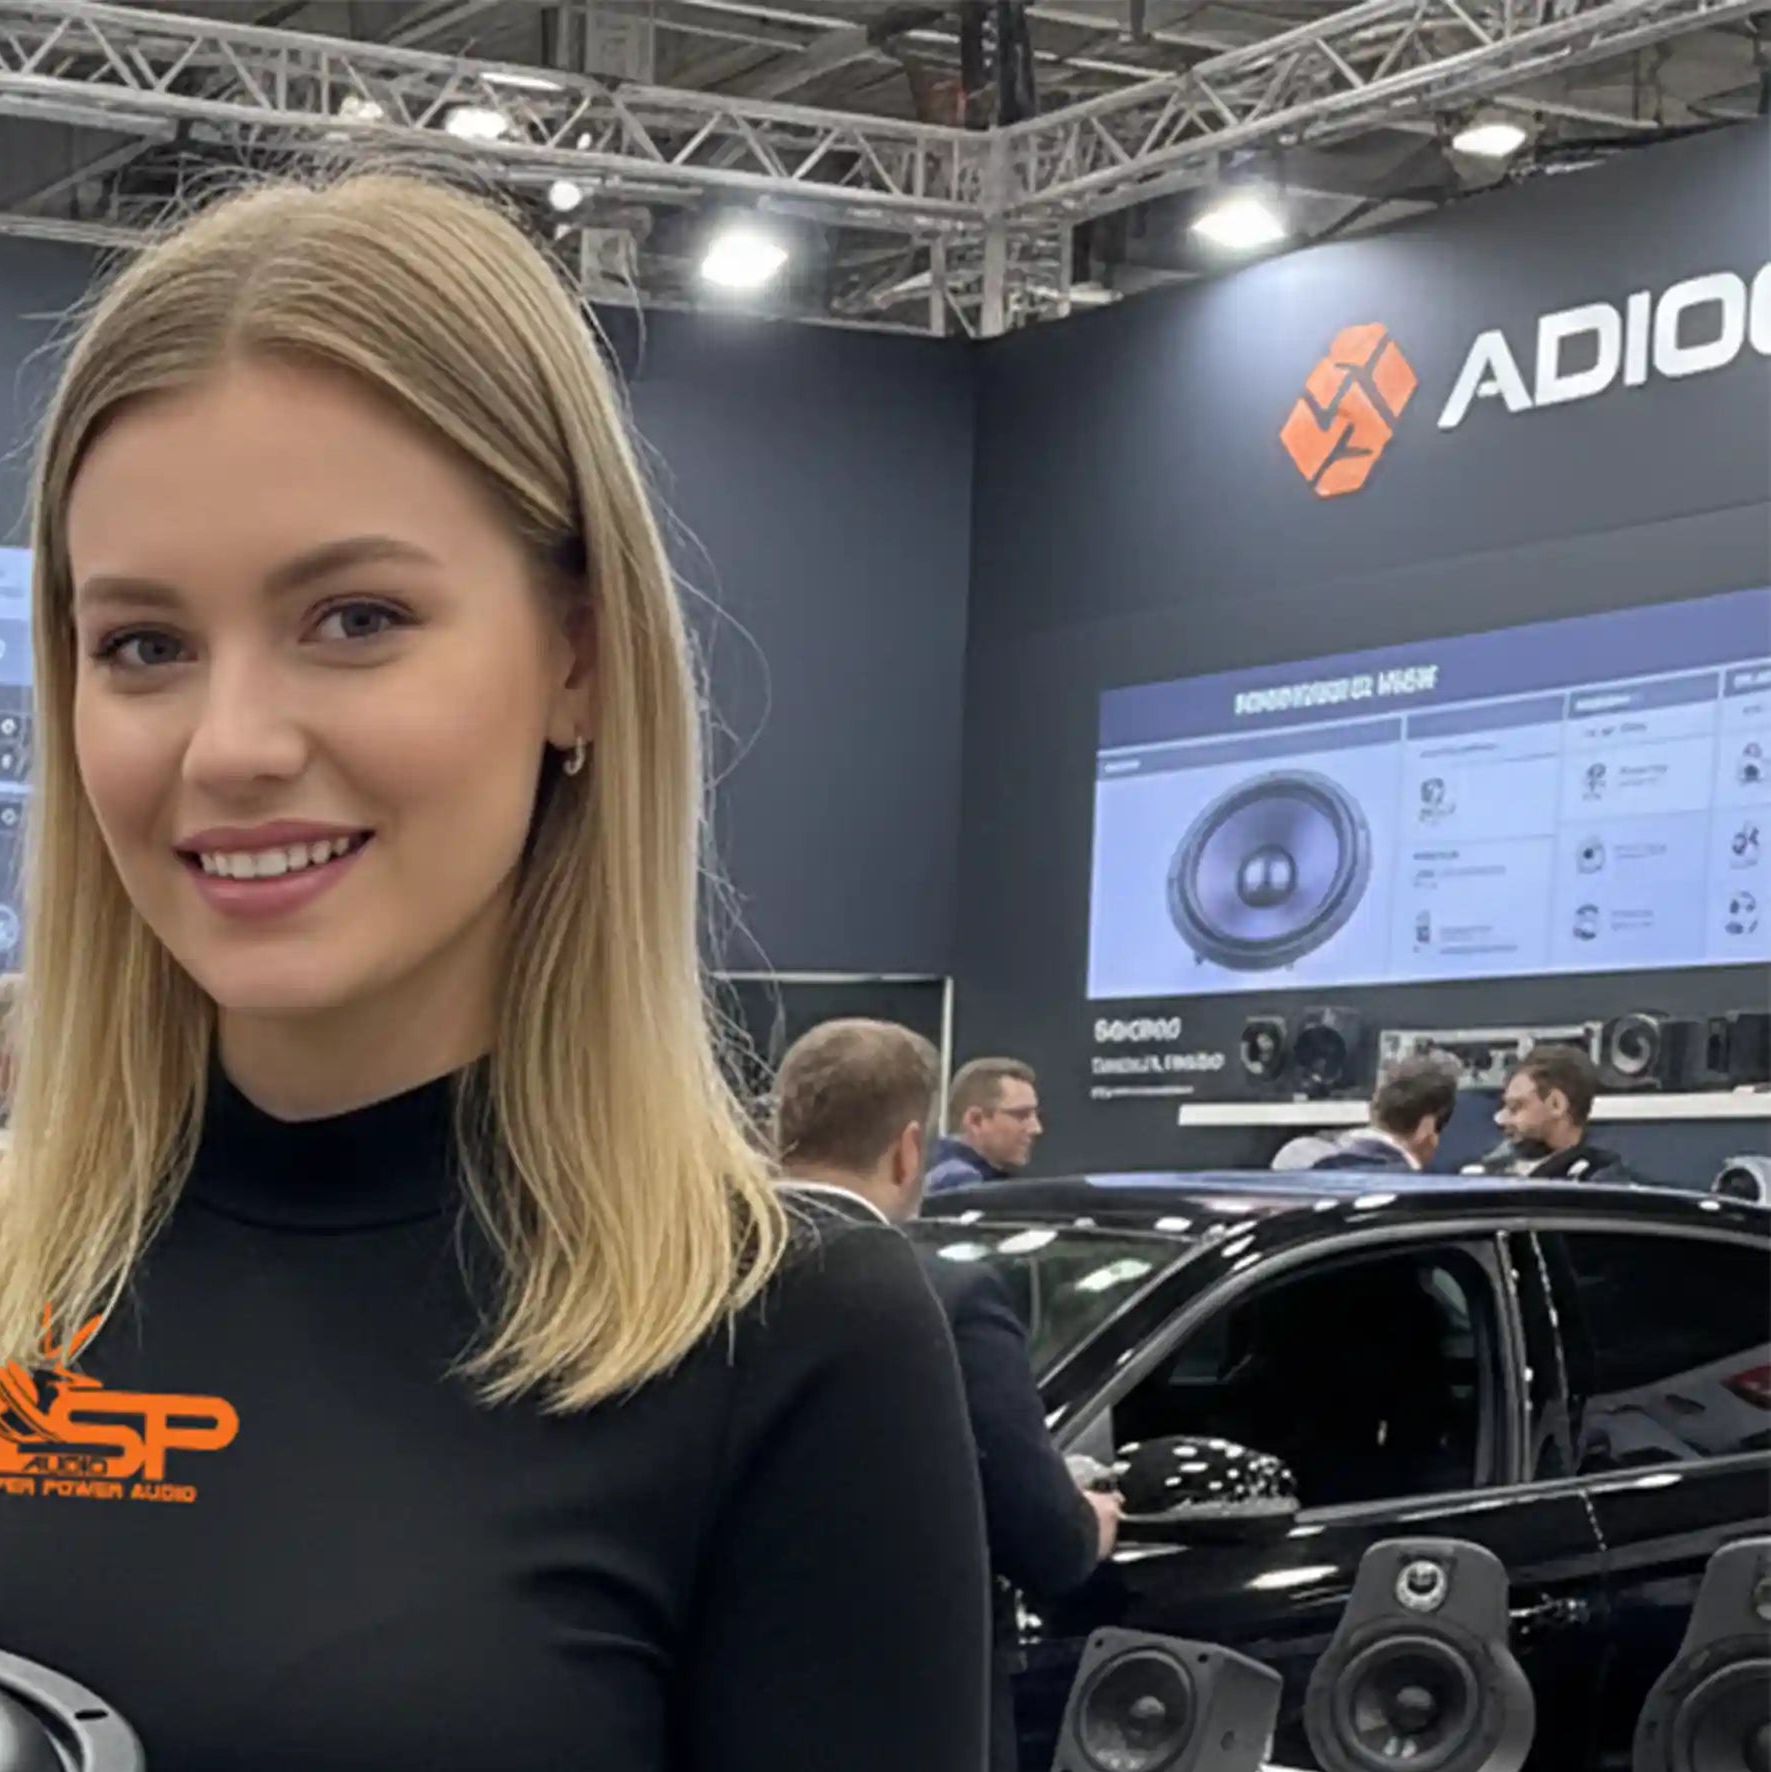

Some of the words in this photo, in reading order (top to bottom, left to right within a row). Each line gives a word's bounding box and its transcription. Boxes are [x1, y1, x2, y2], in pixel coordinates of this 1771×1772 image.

[1437, 262, 1771, 429] ADIO
[42, 1479, 123, 1499] POWER
[131, 1483, 196, 1503] AUDIO
